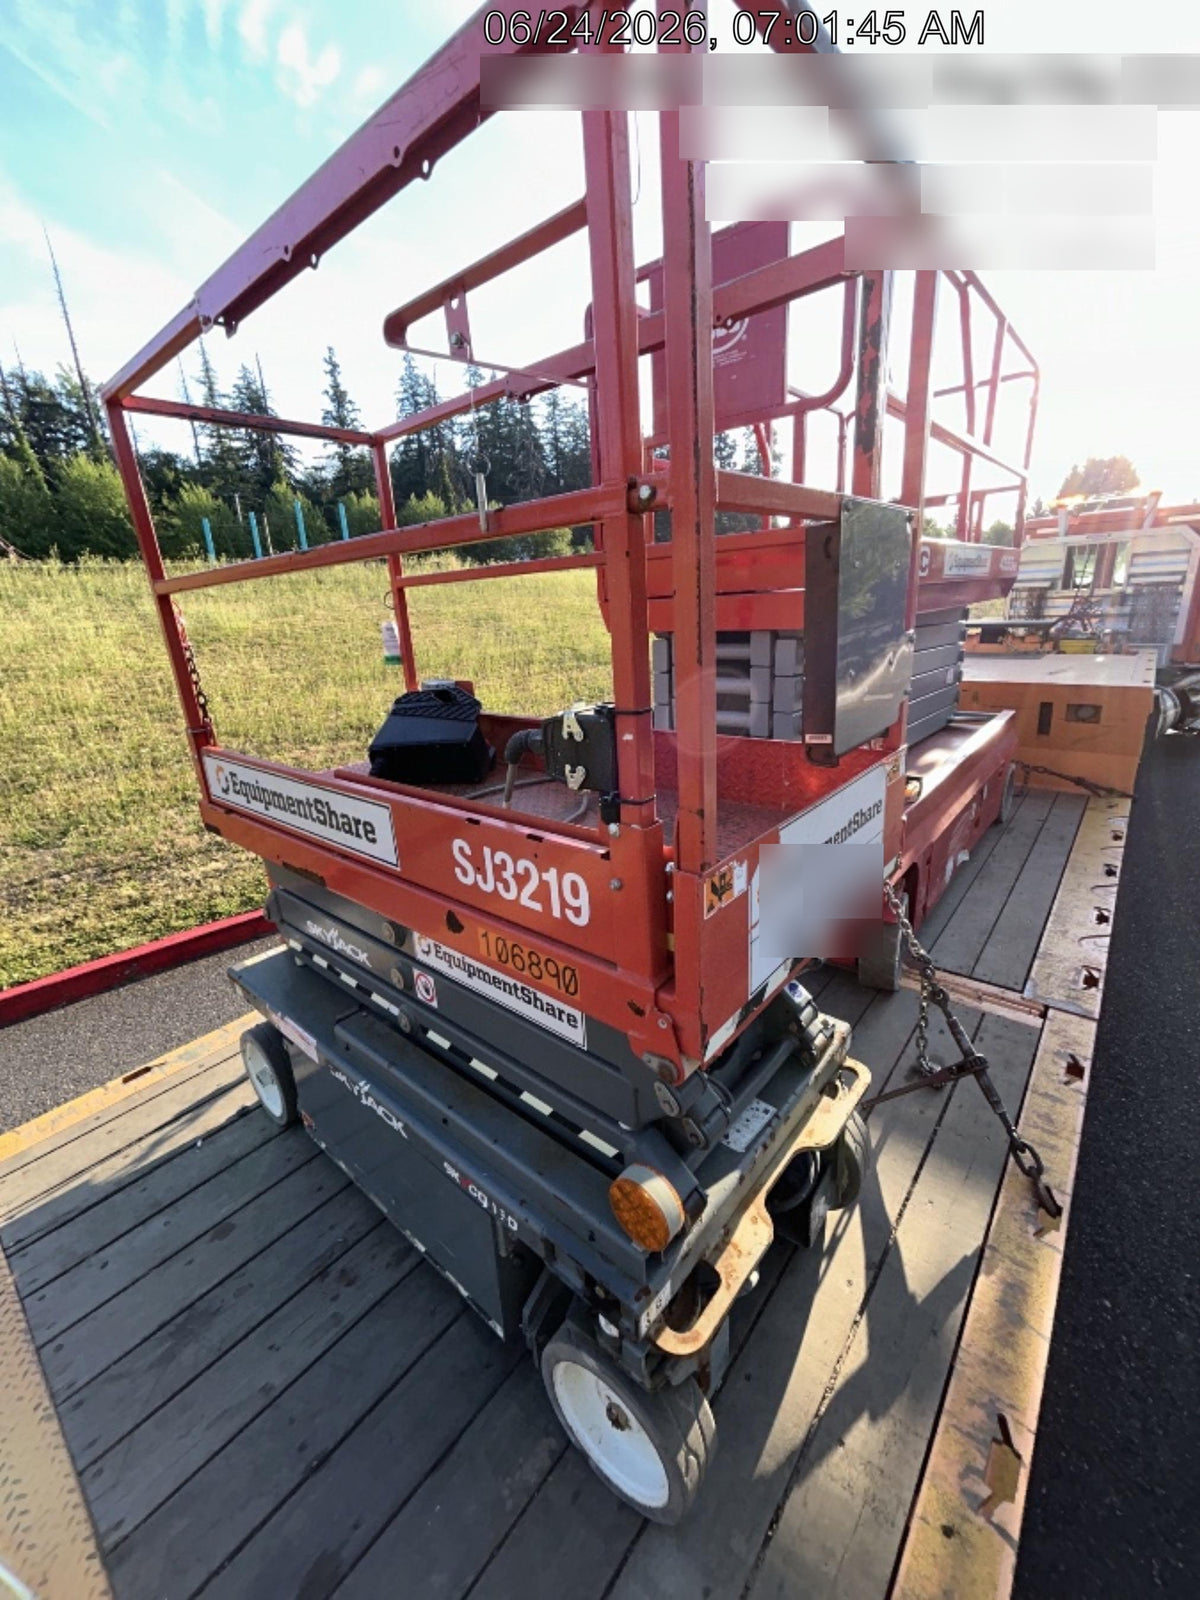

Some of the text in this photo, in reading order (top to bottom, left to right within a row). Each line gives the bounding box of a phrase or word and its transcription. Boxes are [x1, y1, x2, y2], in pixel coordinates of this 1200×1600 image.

[230, 770, 377, 845] EquipmentShare
[452, 838, 591, 927] SJ3219
[434, 943, 580, 1030] EquipmentShare
[480, 931, 580, 997] 106890
